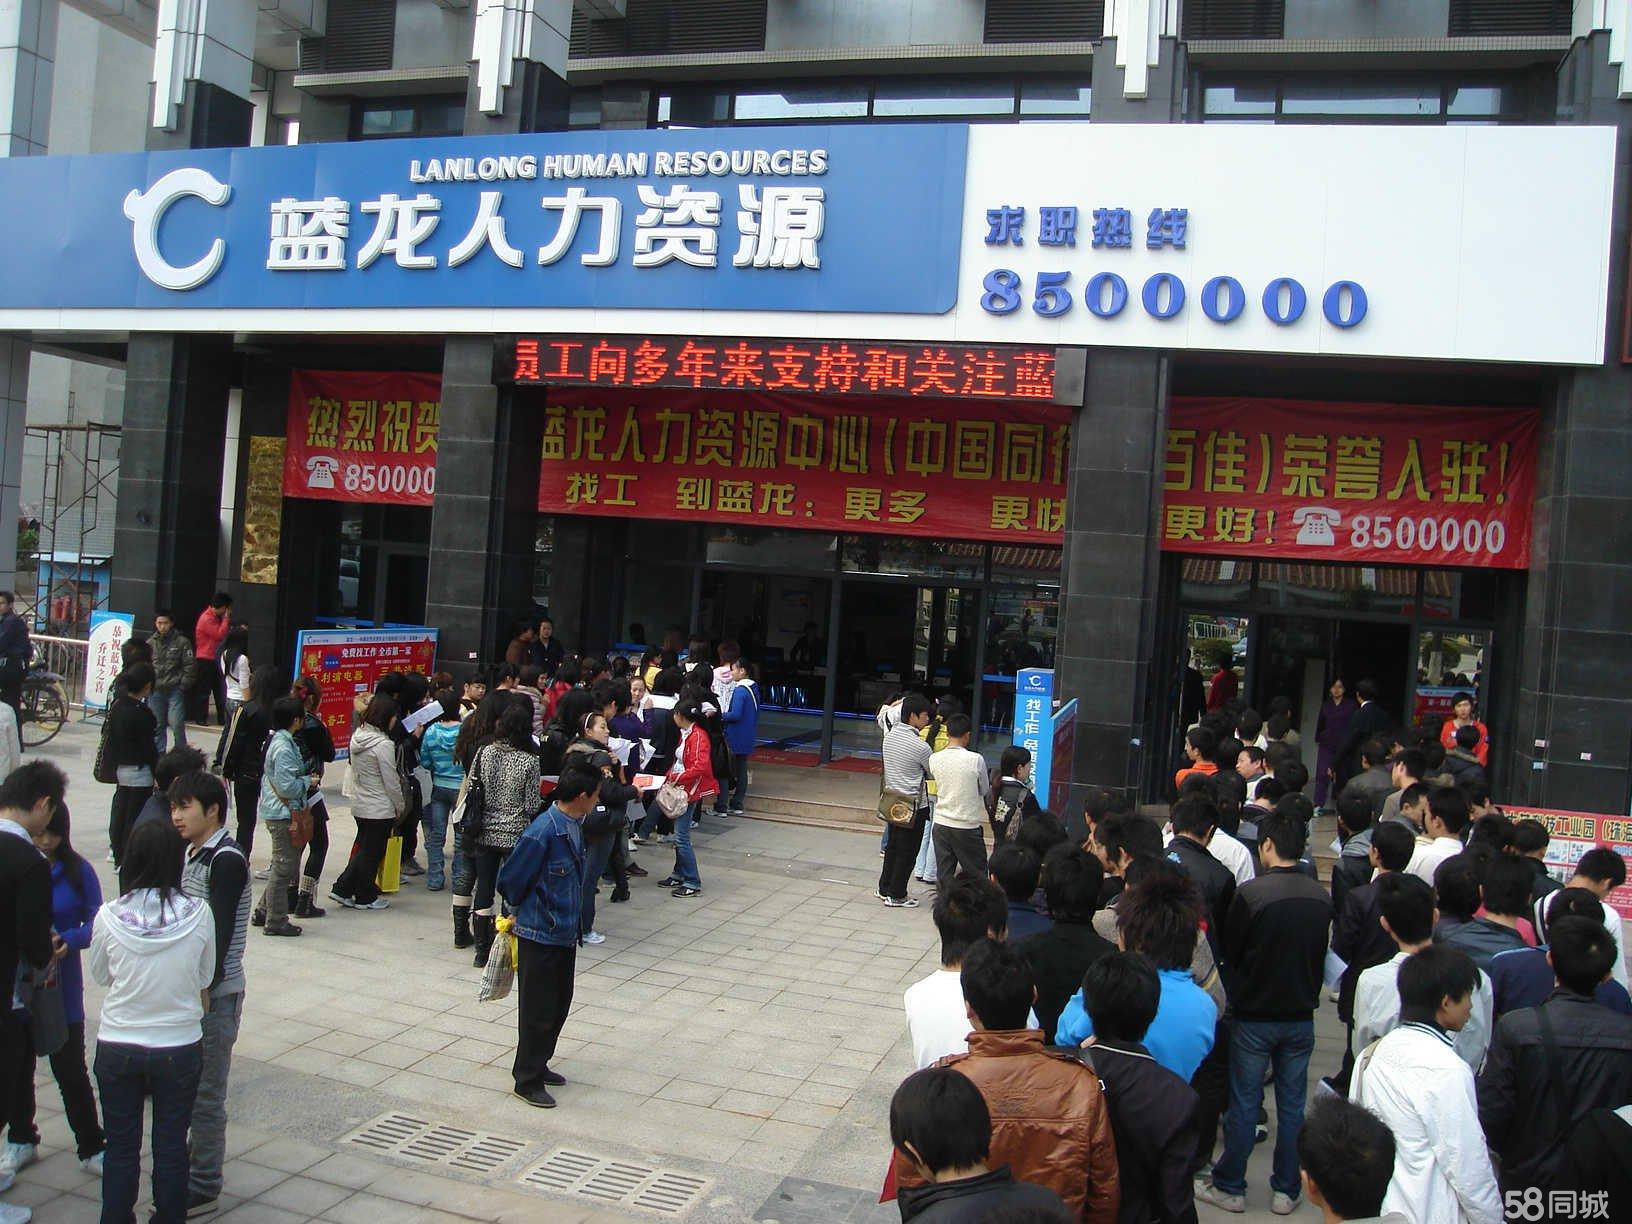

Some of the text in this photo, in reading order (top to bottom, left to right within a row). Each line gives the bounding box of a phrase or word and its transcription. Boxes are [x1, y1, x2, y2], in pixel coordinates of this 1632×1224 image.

[410, 149, 827, 182] LANLONG HUMAN RESOURCES
[266, 184, 825, 271] 蓝龙人力资源
[984, 205, 1188, 250] 求职热线
[980, 268, 1369, 328] 8500000
[514, 340, 1056, 399] 员工向多年来支持和关注蓝
[306, 396, 440, 453] 热烈祝贺
[566, 472, 638, 506] 找工
[1166, 504, 1275, 544] 更好！
[1351, 515, 1505, 554] 8500000
[1025, 699, 1040, 734] 找工作
